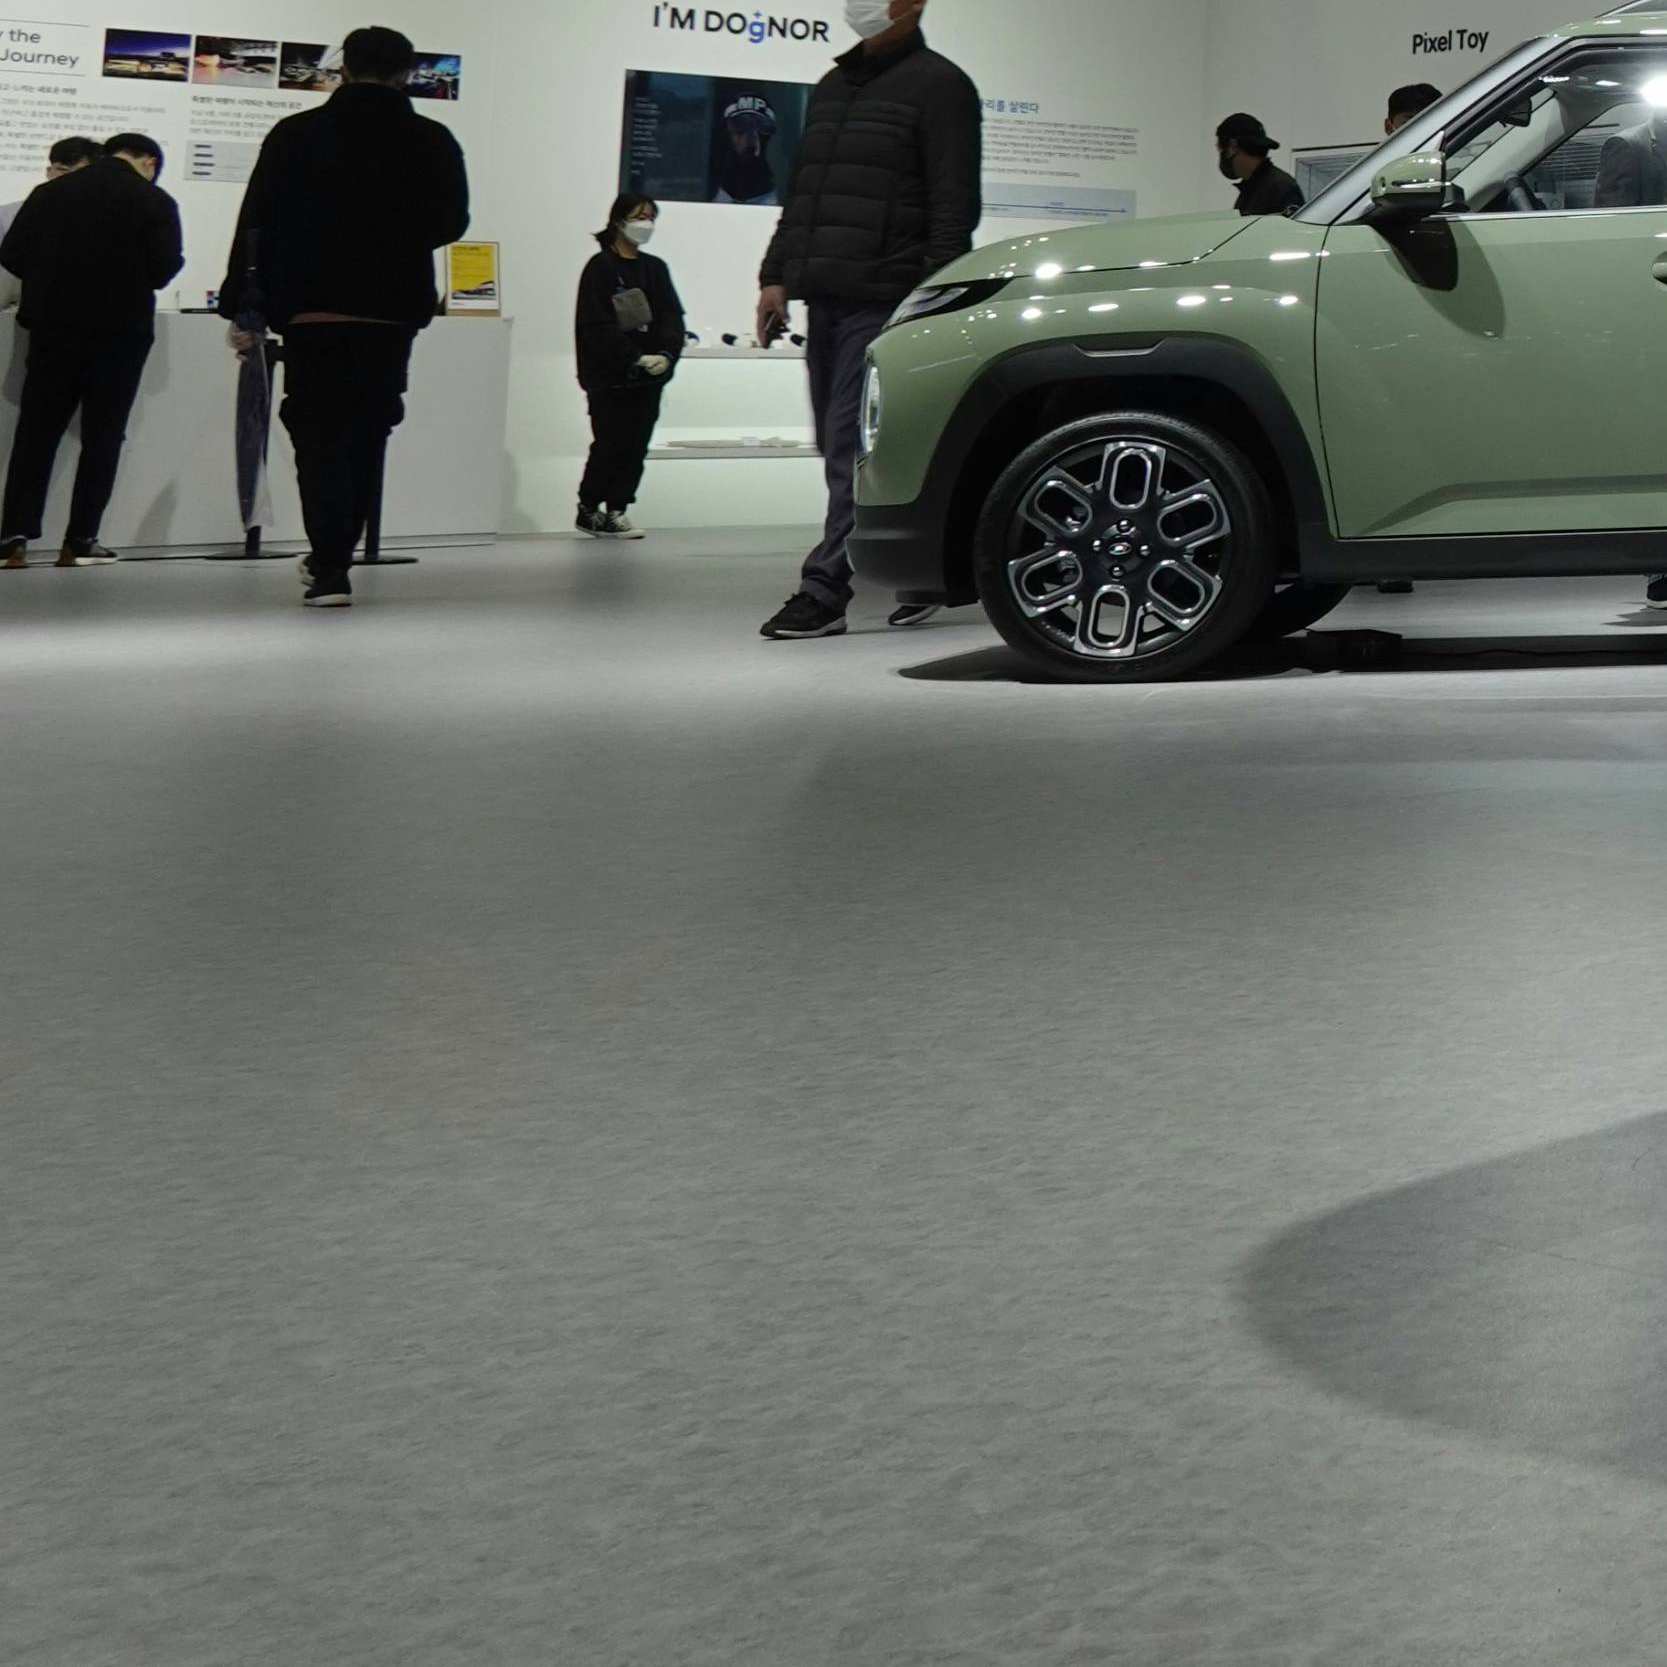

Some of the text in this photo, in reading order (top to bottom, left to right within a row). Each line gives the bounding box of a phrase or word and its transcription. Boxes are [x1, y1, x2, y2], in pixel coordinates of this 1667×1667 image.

[653, 2, 696, 31] I'M
[9, 29, 41, 44] the
[1412, 29, 1489, 55] Pixel Toy
[0, 48, 80, 69] Journey
[736, 96, 767, 111] MP
